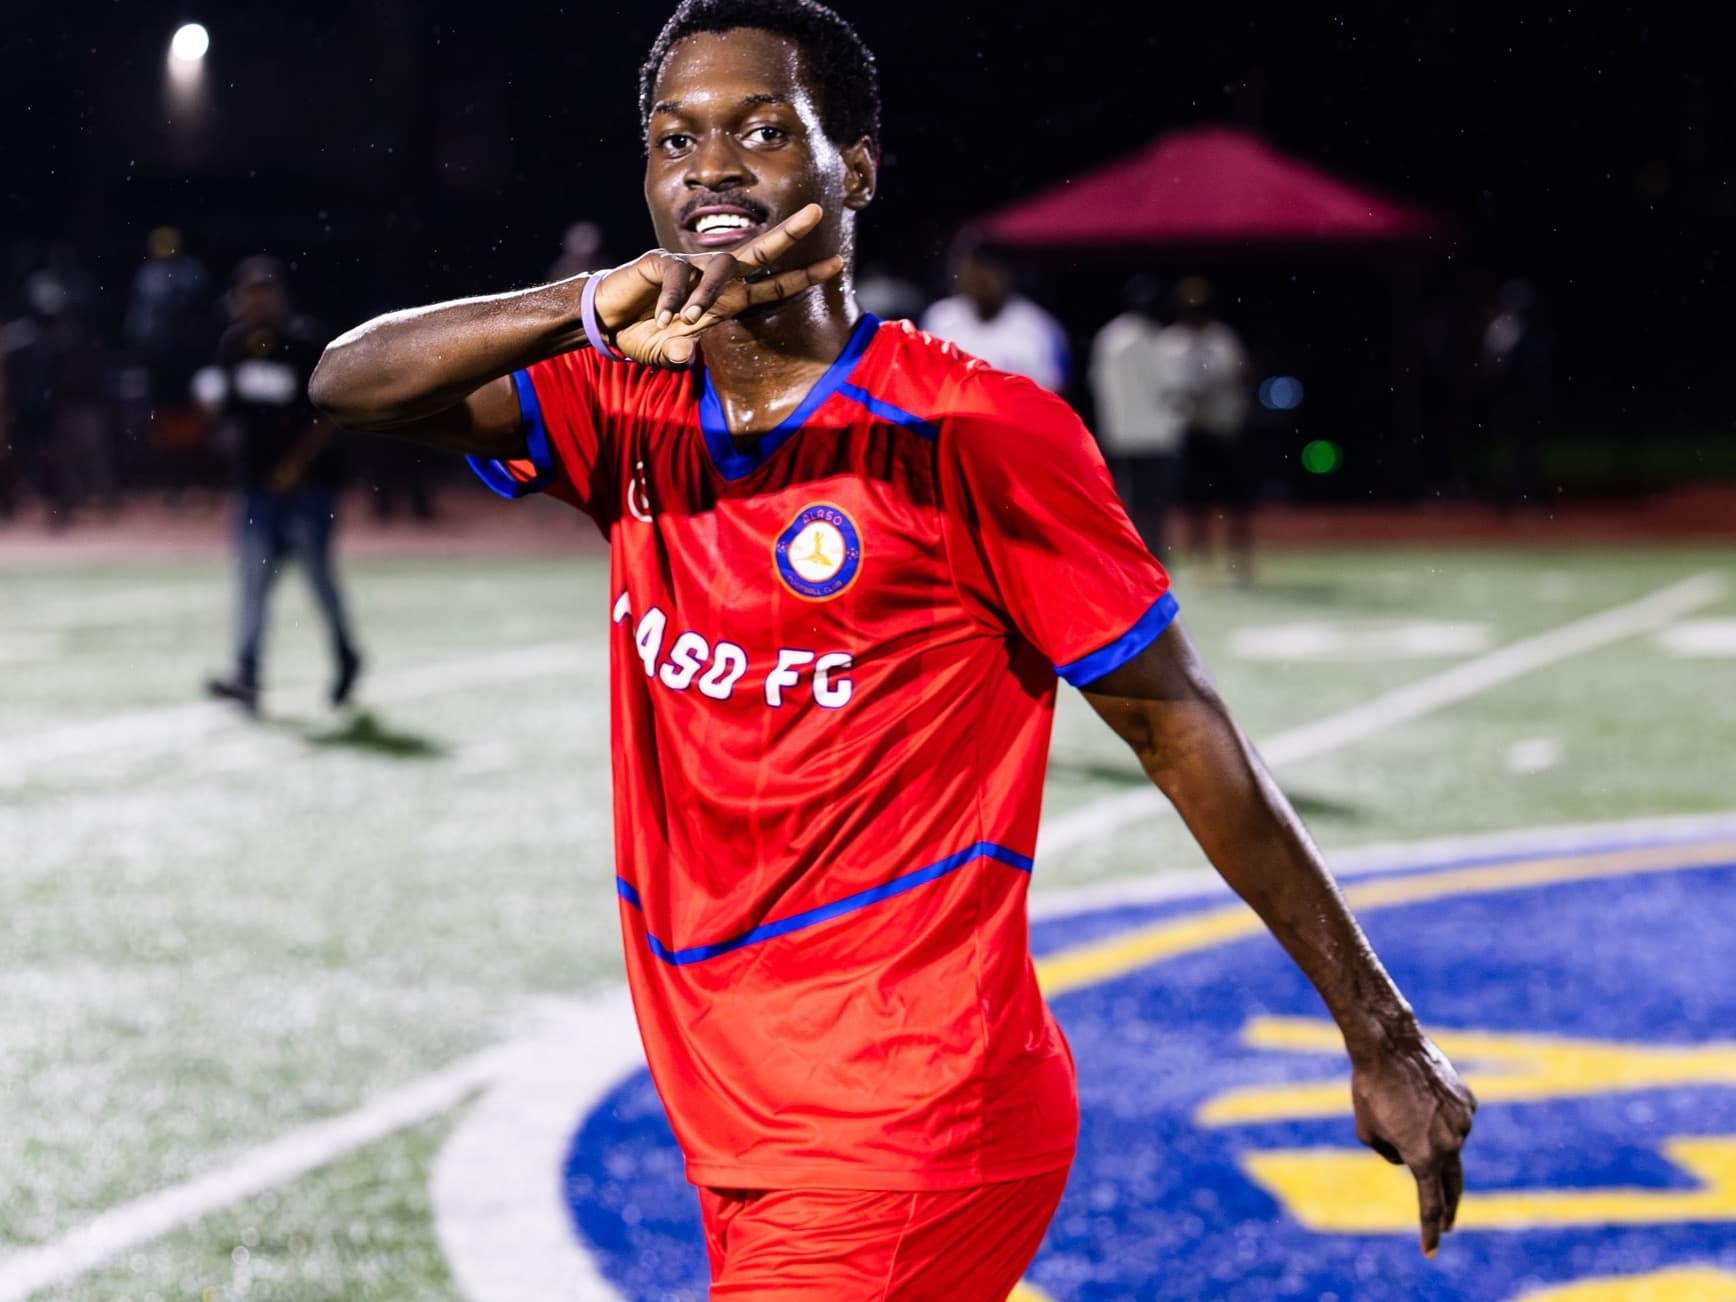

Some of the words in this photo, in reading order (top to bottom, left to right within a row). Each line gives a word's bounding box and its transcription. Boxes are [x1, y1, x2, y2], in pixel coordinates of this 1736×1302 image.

[803, 509, 842, 525] ALASO
[613, 591, 748, 700] ASO
[764, 648, 853, 708] FC
